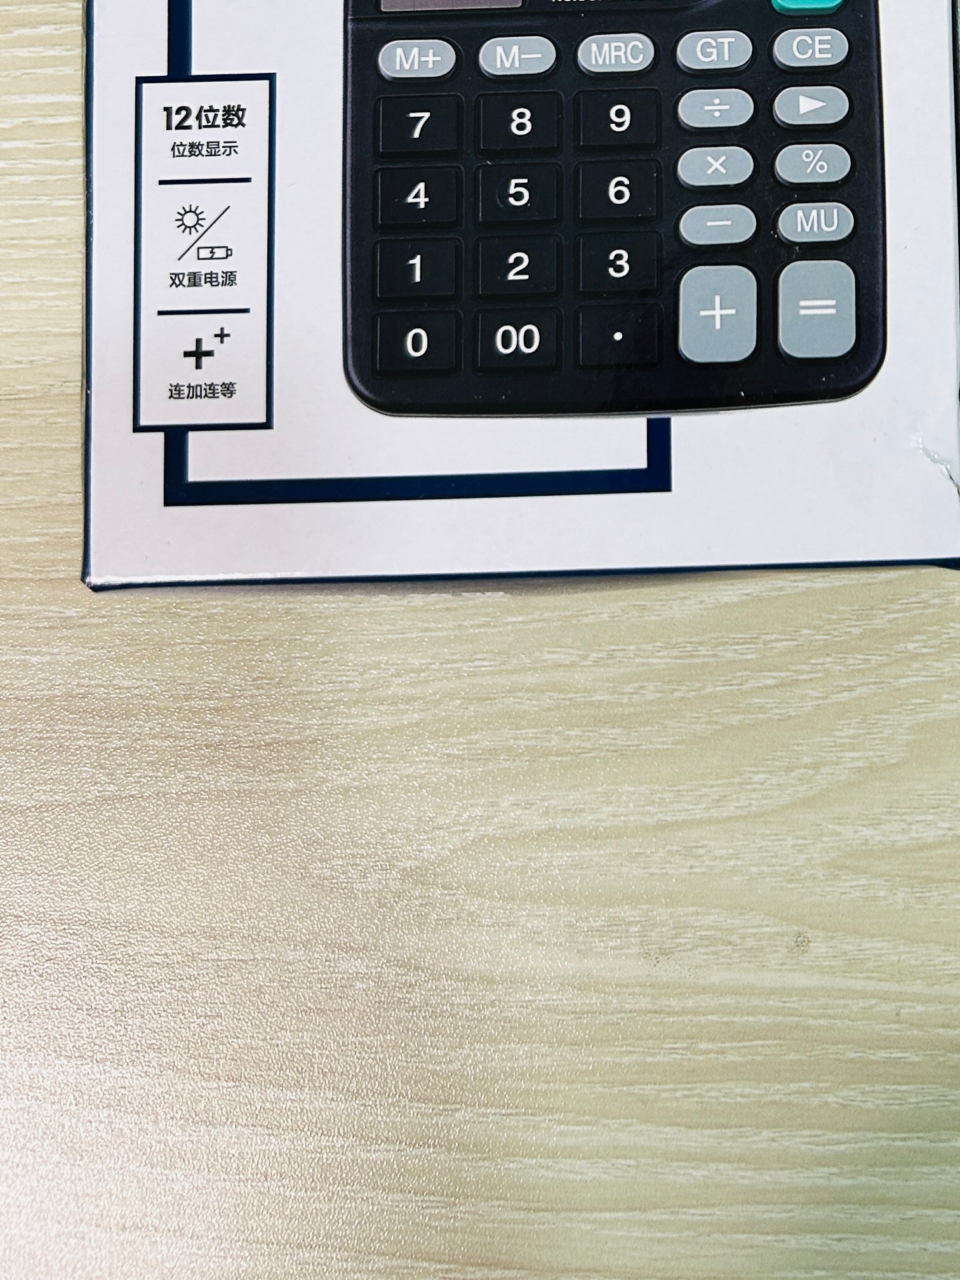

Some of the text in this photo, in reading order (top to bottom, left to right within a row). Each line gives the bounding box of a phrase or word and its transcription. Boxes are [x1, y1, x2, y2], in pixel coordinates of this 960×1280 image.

[395, 47, 442, 71] M+
[591, 41, 644, 65] MRC
[695, 37, 736, 63] GT
[792, 35, 832, 59] CE
[163, 104, 247, 131] 12位数
[408, 111, 431, 139] 7
[510, 107, 532, 136] 8
[609, 104, 631, 132] 9
[170, 140, 239, 159] 位数显示
[801, 149, 828, 174] %
[406, 181, 430, 209] 4
[508, 178, 530, 206] 5
[608, 176, 631, 205] 6
[796, 208, 838, 233] MU
[408, 254, 421, 283] 1
[507, 251, 530, 281] 2
[608, 249, 630, 278] 3
[169, 270, 238, 289] 双重电源
[406, 327, 428, 358] 0
[495, 324, 540, 355] 00
[168, 381, 237, 400] 连加连等
